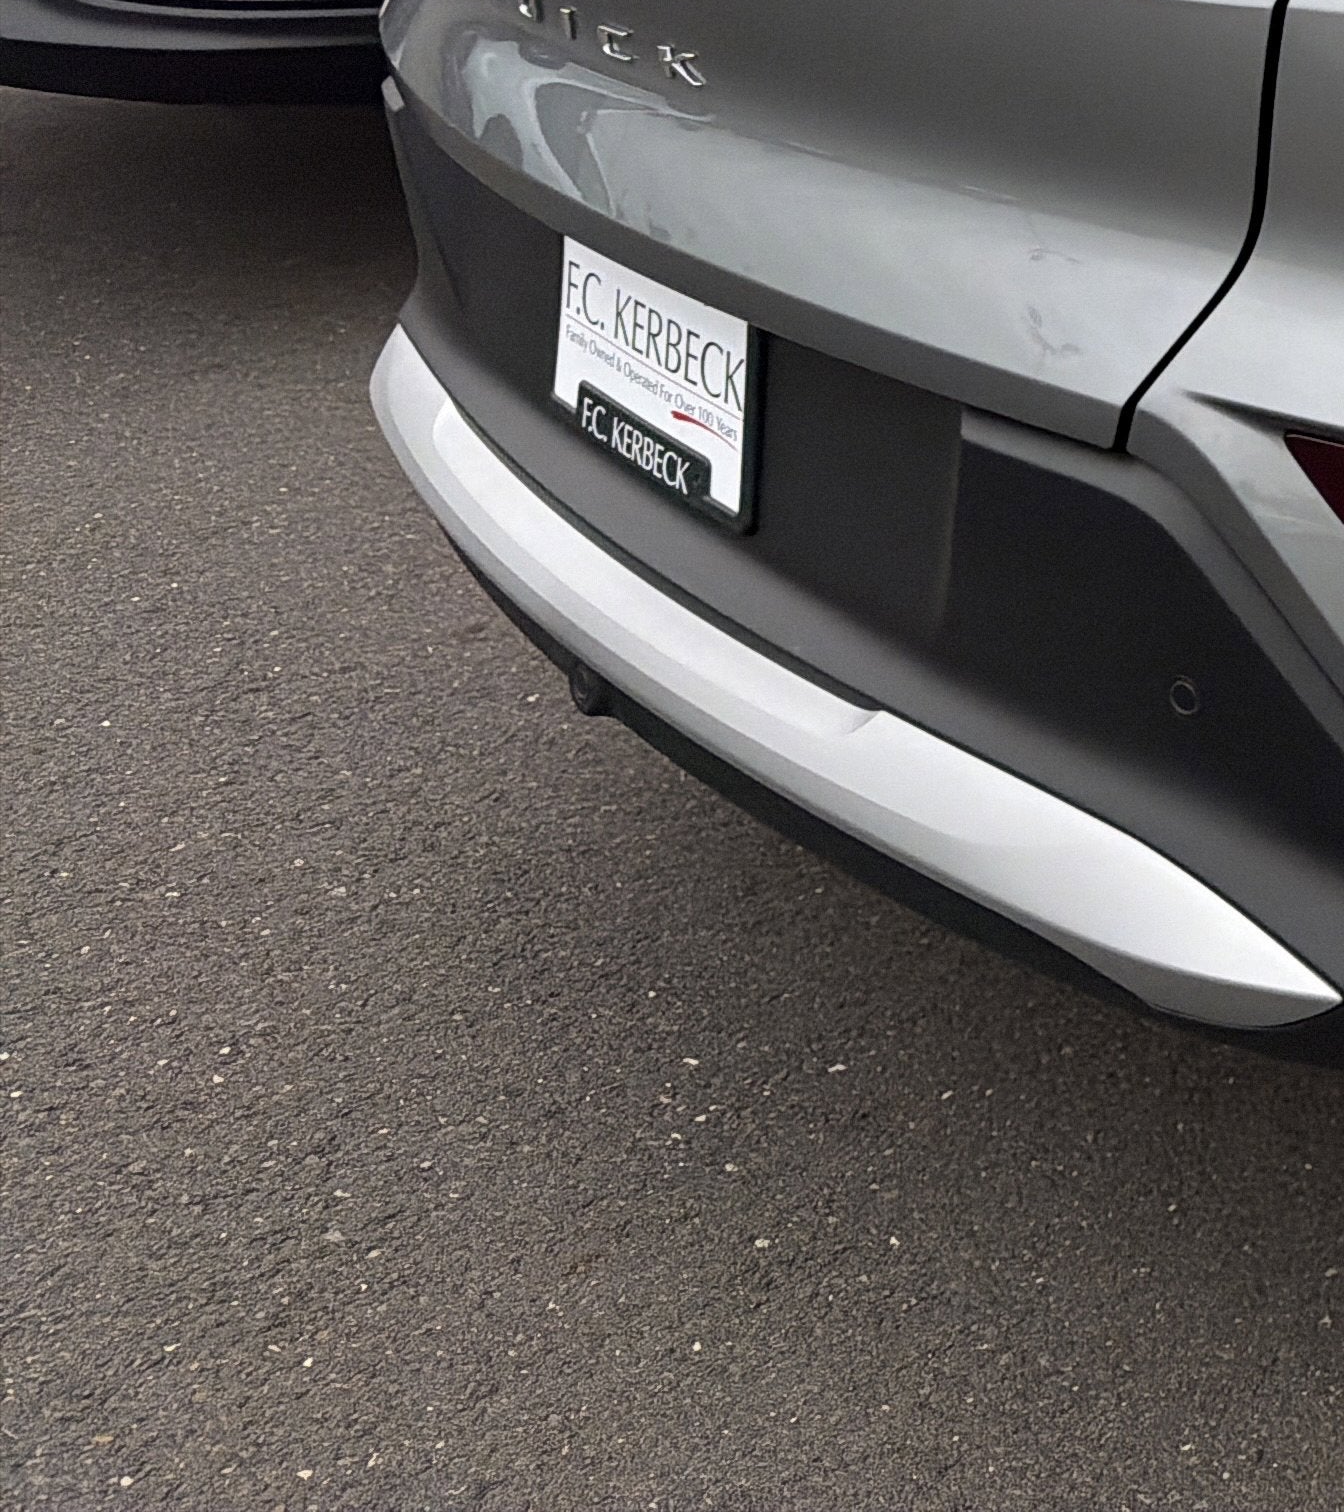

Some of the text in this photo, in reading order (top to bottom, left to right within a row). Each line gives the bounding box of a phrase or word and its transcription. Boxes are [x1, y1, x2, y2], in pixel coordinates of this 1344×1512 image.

[566, 260, 745, 412] F.C. KERBECK
[659, 382, 673, 403] For
[674, 393, 696, 416] Over
[698, 406, 714, 426] 100
[611, 416, 690, 495] KERBECK
